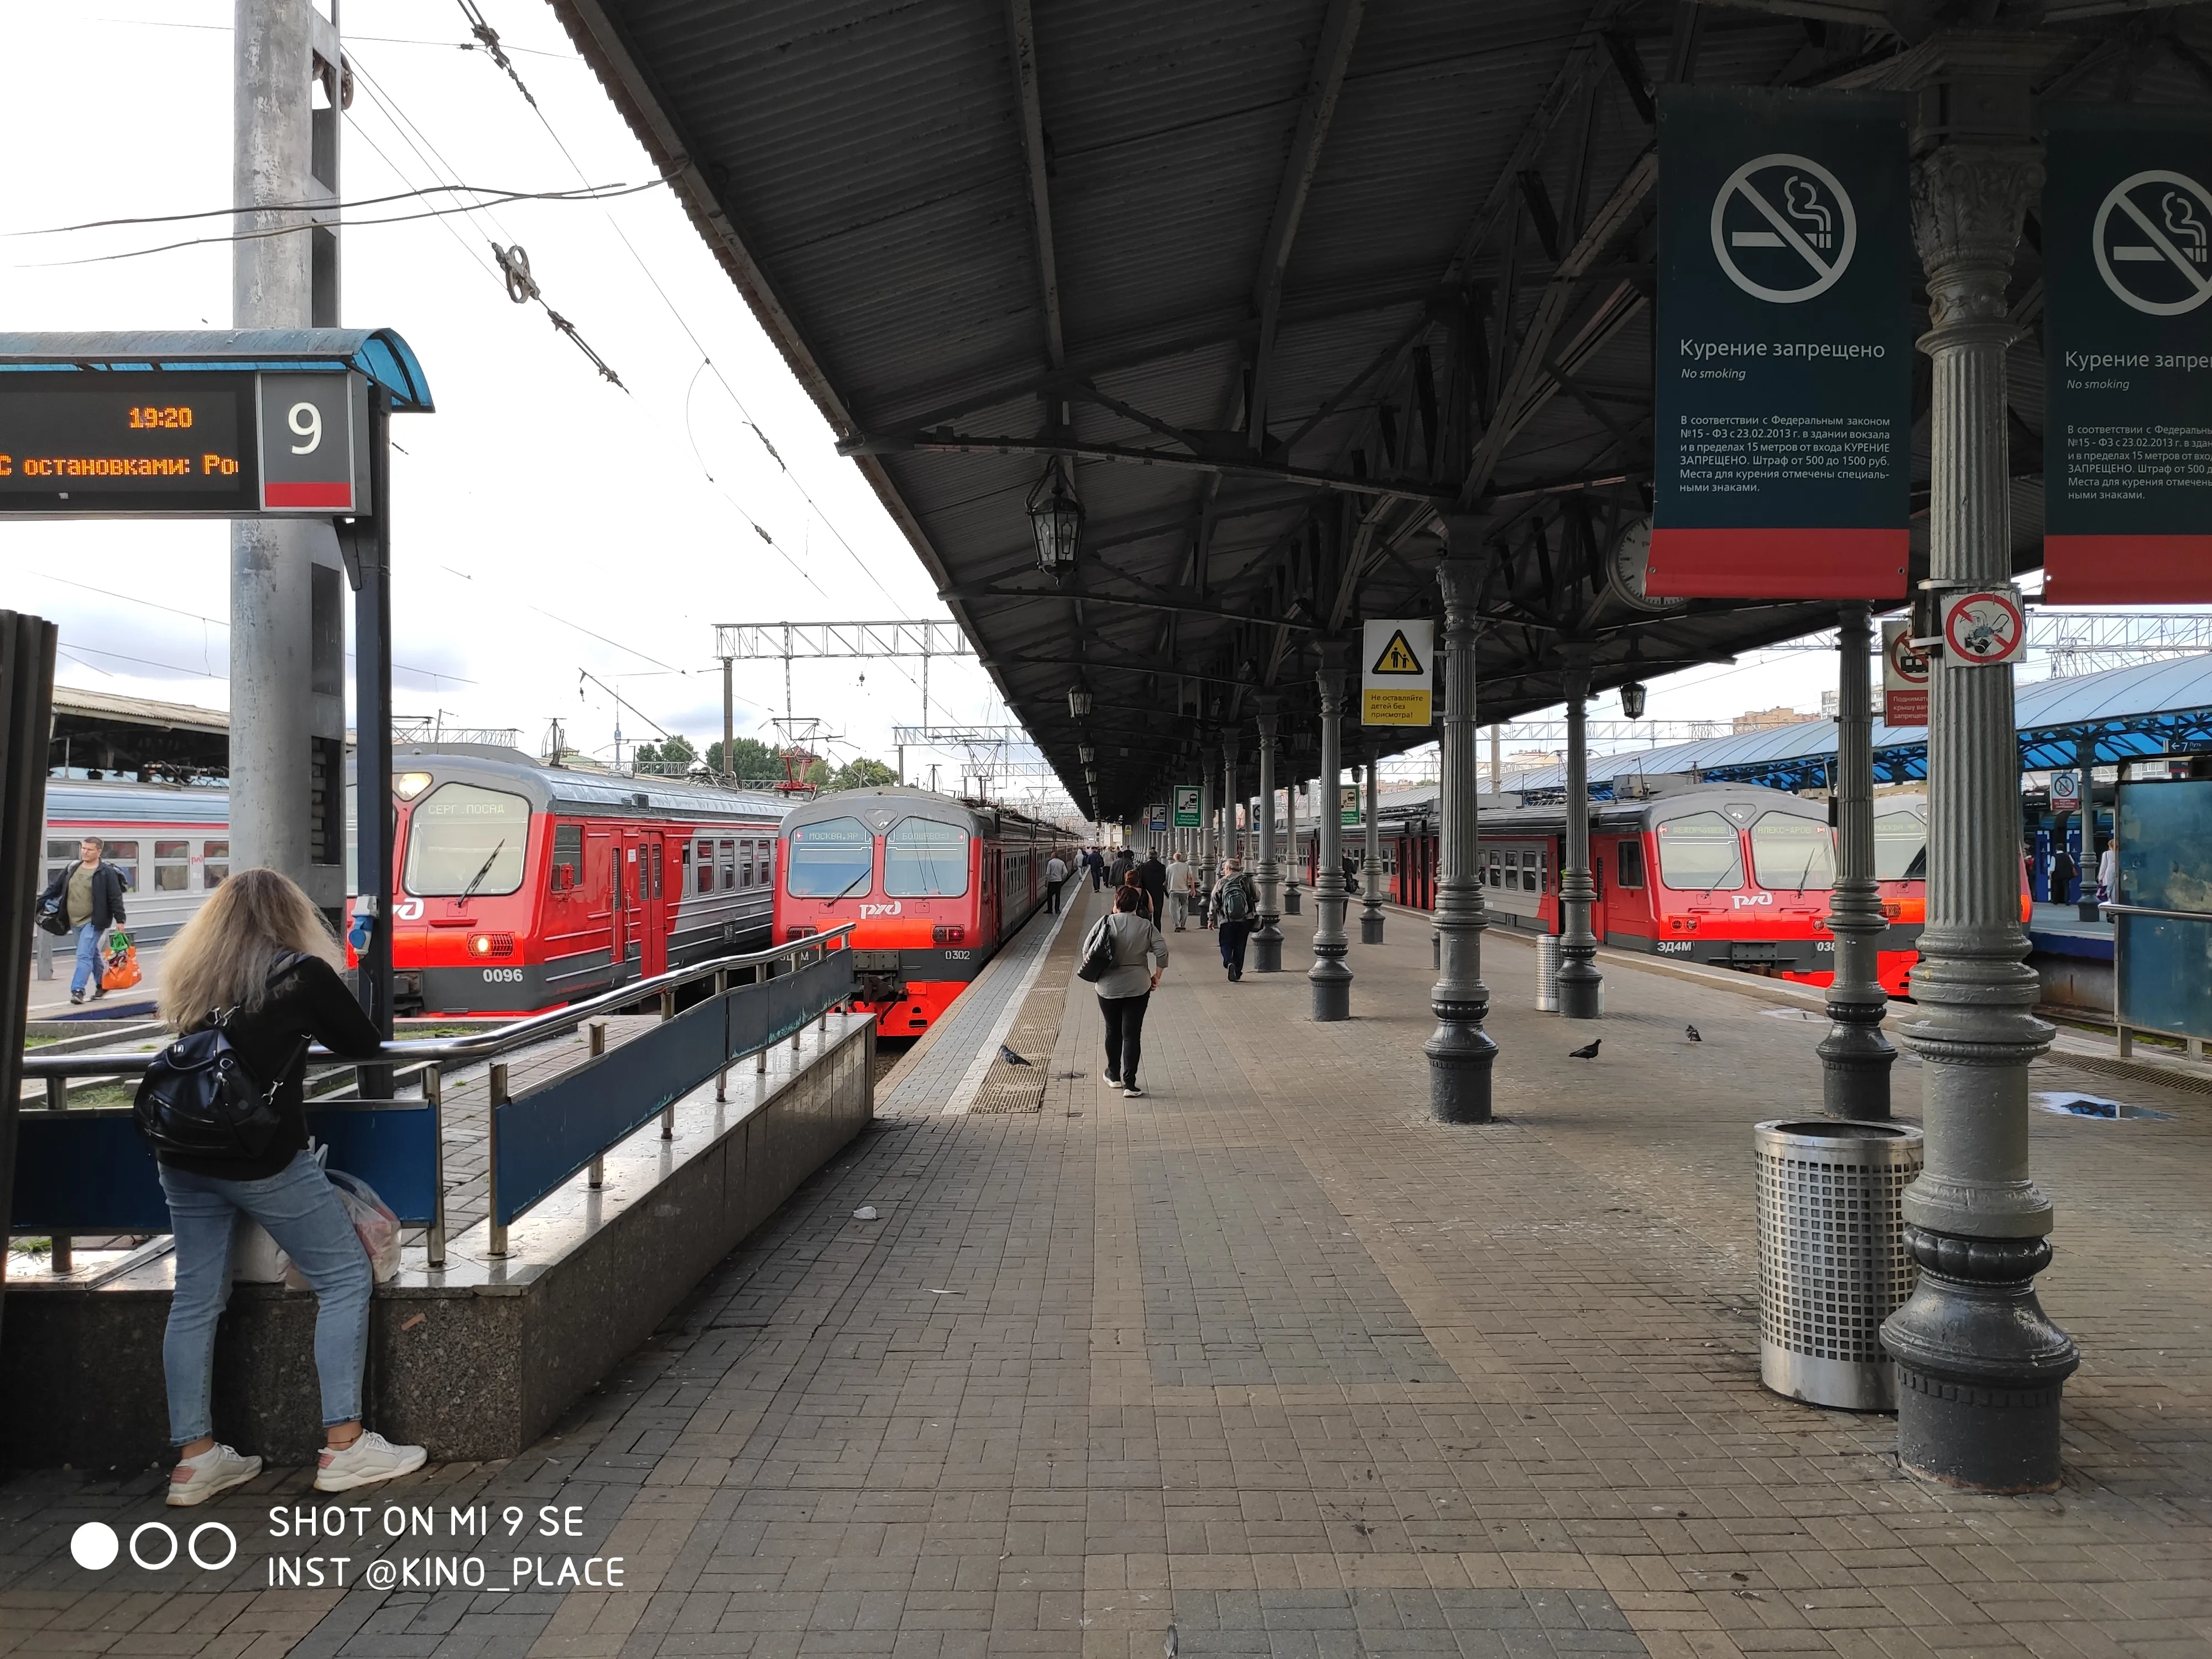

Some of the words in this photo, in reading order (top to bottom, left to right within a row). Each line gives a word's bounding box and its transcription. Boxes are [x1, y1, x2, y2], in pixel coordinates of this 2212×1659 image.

[1681, 339, 1767, 361] Курение
[1773, 343, 1885, 361] запрещено
[2066, 351, 2149, 372] Курение
[2154, 355, 2212, 372] запре
[1681, 368, 1697, 378] No
[1699, 368, 1746, 381] smoking
[2067, 379, 2082, 389] No
[2084, 378, 2130, 391] smoking
[129, 407, 192, 428] 19:20
[1681, 415, 1687, 425] В
[1771, 415, 1843, 427] Федеральным
[288, 402, 322, 455] 9
[1681, 429, 1703, 439] №15
[1712, 429, 1728, 438] ФЗ
[1736, 429, 1791, 438] 23.02.2013
[1811, 431, 1847, 440] здании
[2068, 425, 2074, 434] В
[1697, 444, 1745, 454] пределах
[1747, 442, 1759, 451] 15
[1760, 444, 1798, 454] метров
[1813, 444, 1842, 453] входа
[1844, 442, 1890, 452] КУРЕНИЕ
[2068, 438, 2090, 447] №15
[2098, 437, 2114, 447] ФЗ
[2122, 437, 2173, 447] 23.02.2013
[1680, 455, 1750, 467] ЗАПРЕЩЕНО.
[1753, 455, 1788, 467] Штраф
[1806, 456, 1824, 465] 500
[1826, 458, 1839, 466] до
[1843, 456, 1866, 466] 1500
[1869, 456, 1890, 468] руб.
[2084, 453, 2130, 462] пределах
[2132, 451, 2143, 460] 15
[2145, 453, 2180, 462] метров
[23, 459, 190, 476] остановками:
[202, 455, 238, 476] Ро
[2068, 464, 2135, 474] ЗАПРЕЩЕНО.
[2138, 464, 2172, 475] Штраф
[2188, 464, 2205, 473] 500
[1680, 469, 1713, 478] Места
[1714, 471, 1733, 480] для
[1736, 471, 1779, 481] курения
[1837, 471, 1890, 480] специаль-
[2068, 477, 2100, 486] Места
[2101, 479, 2120, 487] для
[2122, 479, 2163, 488] курения
[2181, 742, 2188, 752] 7
[1657, 941, 1692, 952] ЭД4М
[945, 950, 971, 960] 0302
[482, 969, 524, 983] 0096
